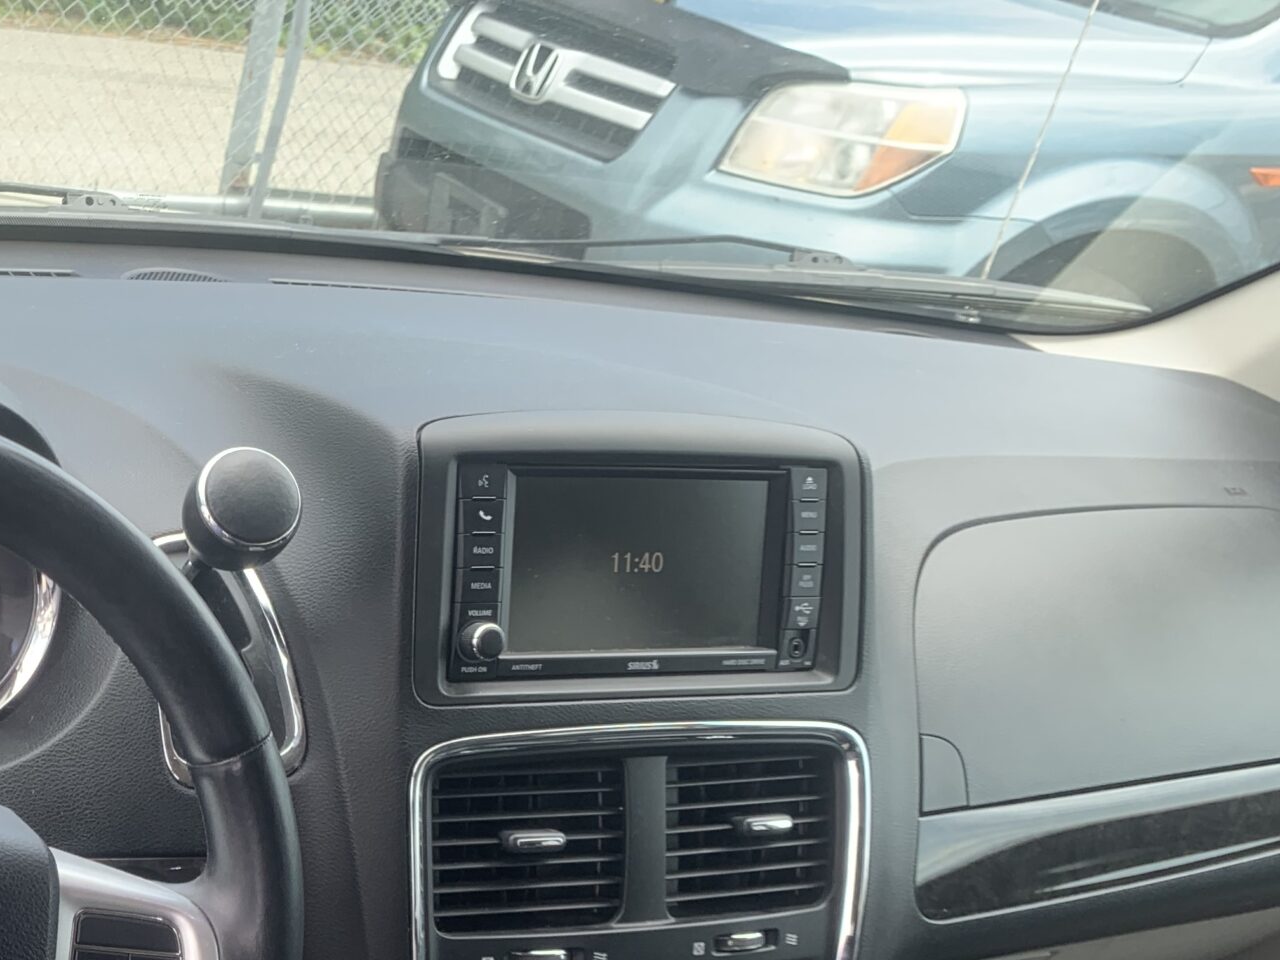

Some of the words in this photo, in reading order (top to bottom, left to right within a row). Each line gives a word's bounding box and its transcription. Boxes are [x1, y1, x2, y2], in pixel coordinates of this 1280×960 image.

[473, 546, 494, 554] RADIO
[611, 552, 664, 573] 11:40
[471, 582, 492, 590] MEDIA
